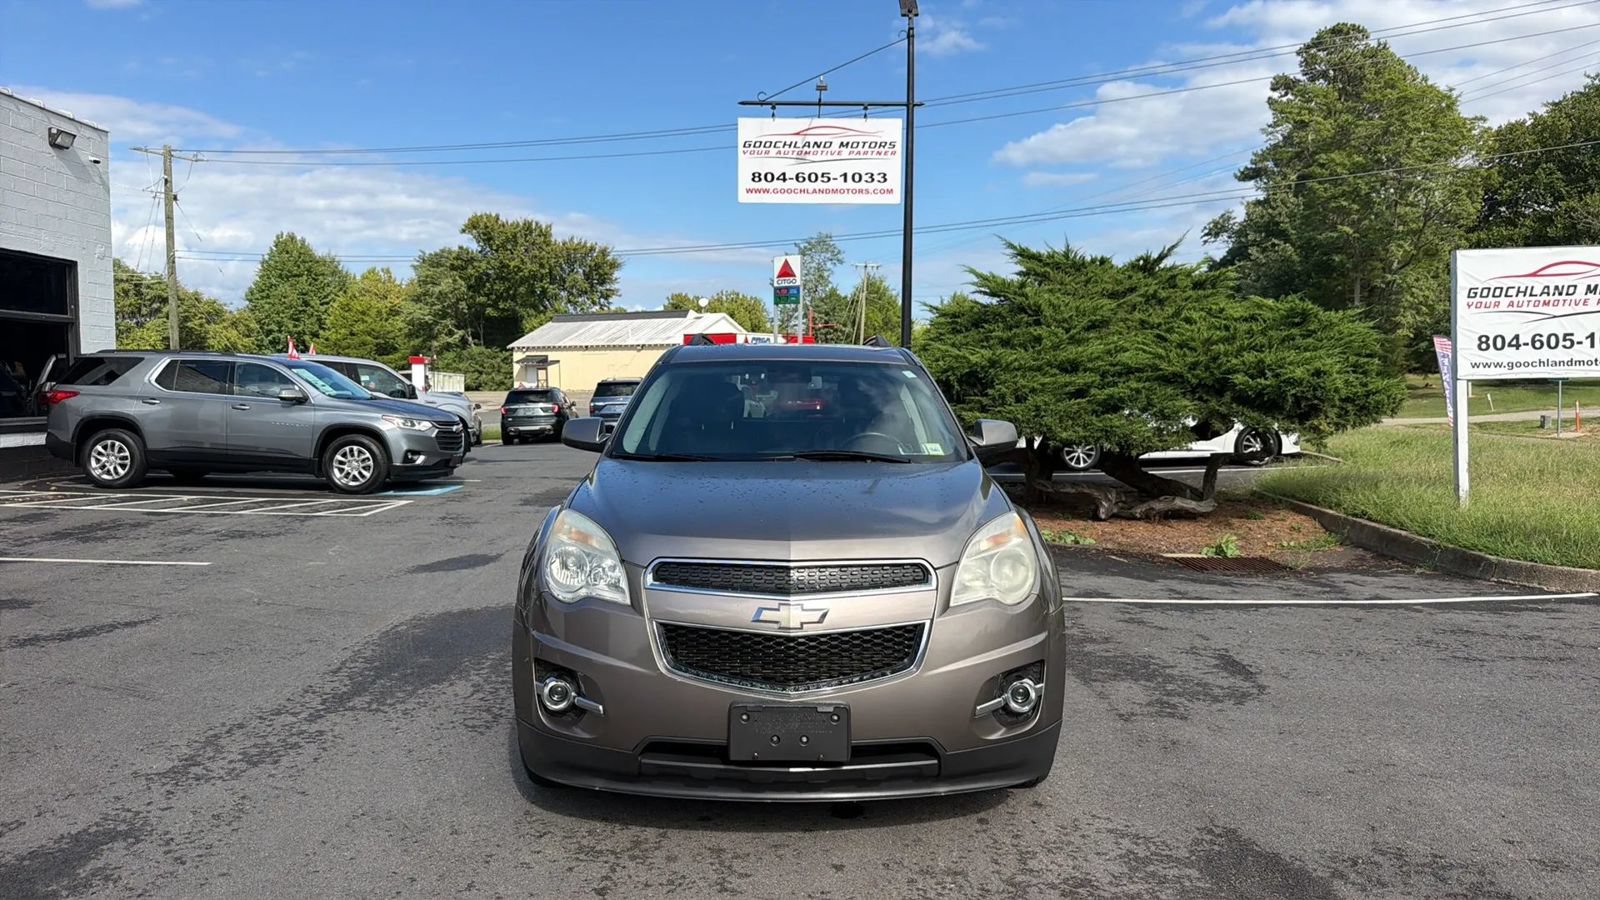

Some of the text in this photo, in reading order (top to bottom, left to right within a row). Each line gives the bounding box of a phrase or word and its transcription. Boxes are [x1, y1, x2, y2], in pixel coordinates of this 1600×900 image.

[742, 140, 897, 149] GOOCHLAND MOTORS
[750, 171, 888, 183] 804-605-1033
[745, 187, 894, 195] WWW.GOOCHLANDMOTORS.COM
[1466, 283, 1600, 299] GOOCHLAND M
[1466, 300, 1501, 309] YOUR
[1506, 298, 1591, 308] AUTOMOTIVE
[1476, 331, 1600, 351] 804-605-1
[1470, 357, 1600, 370] www.goochlandmot
